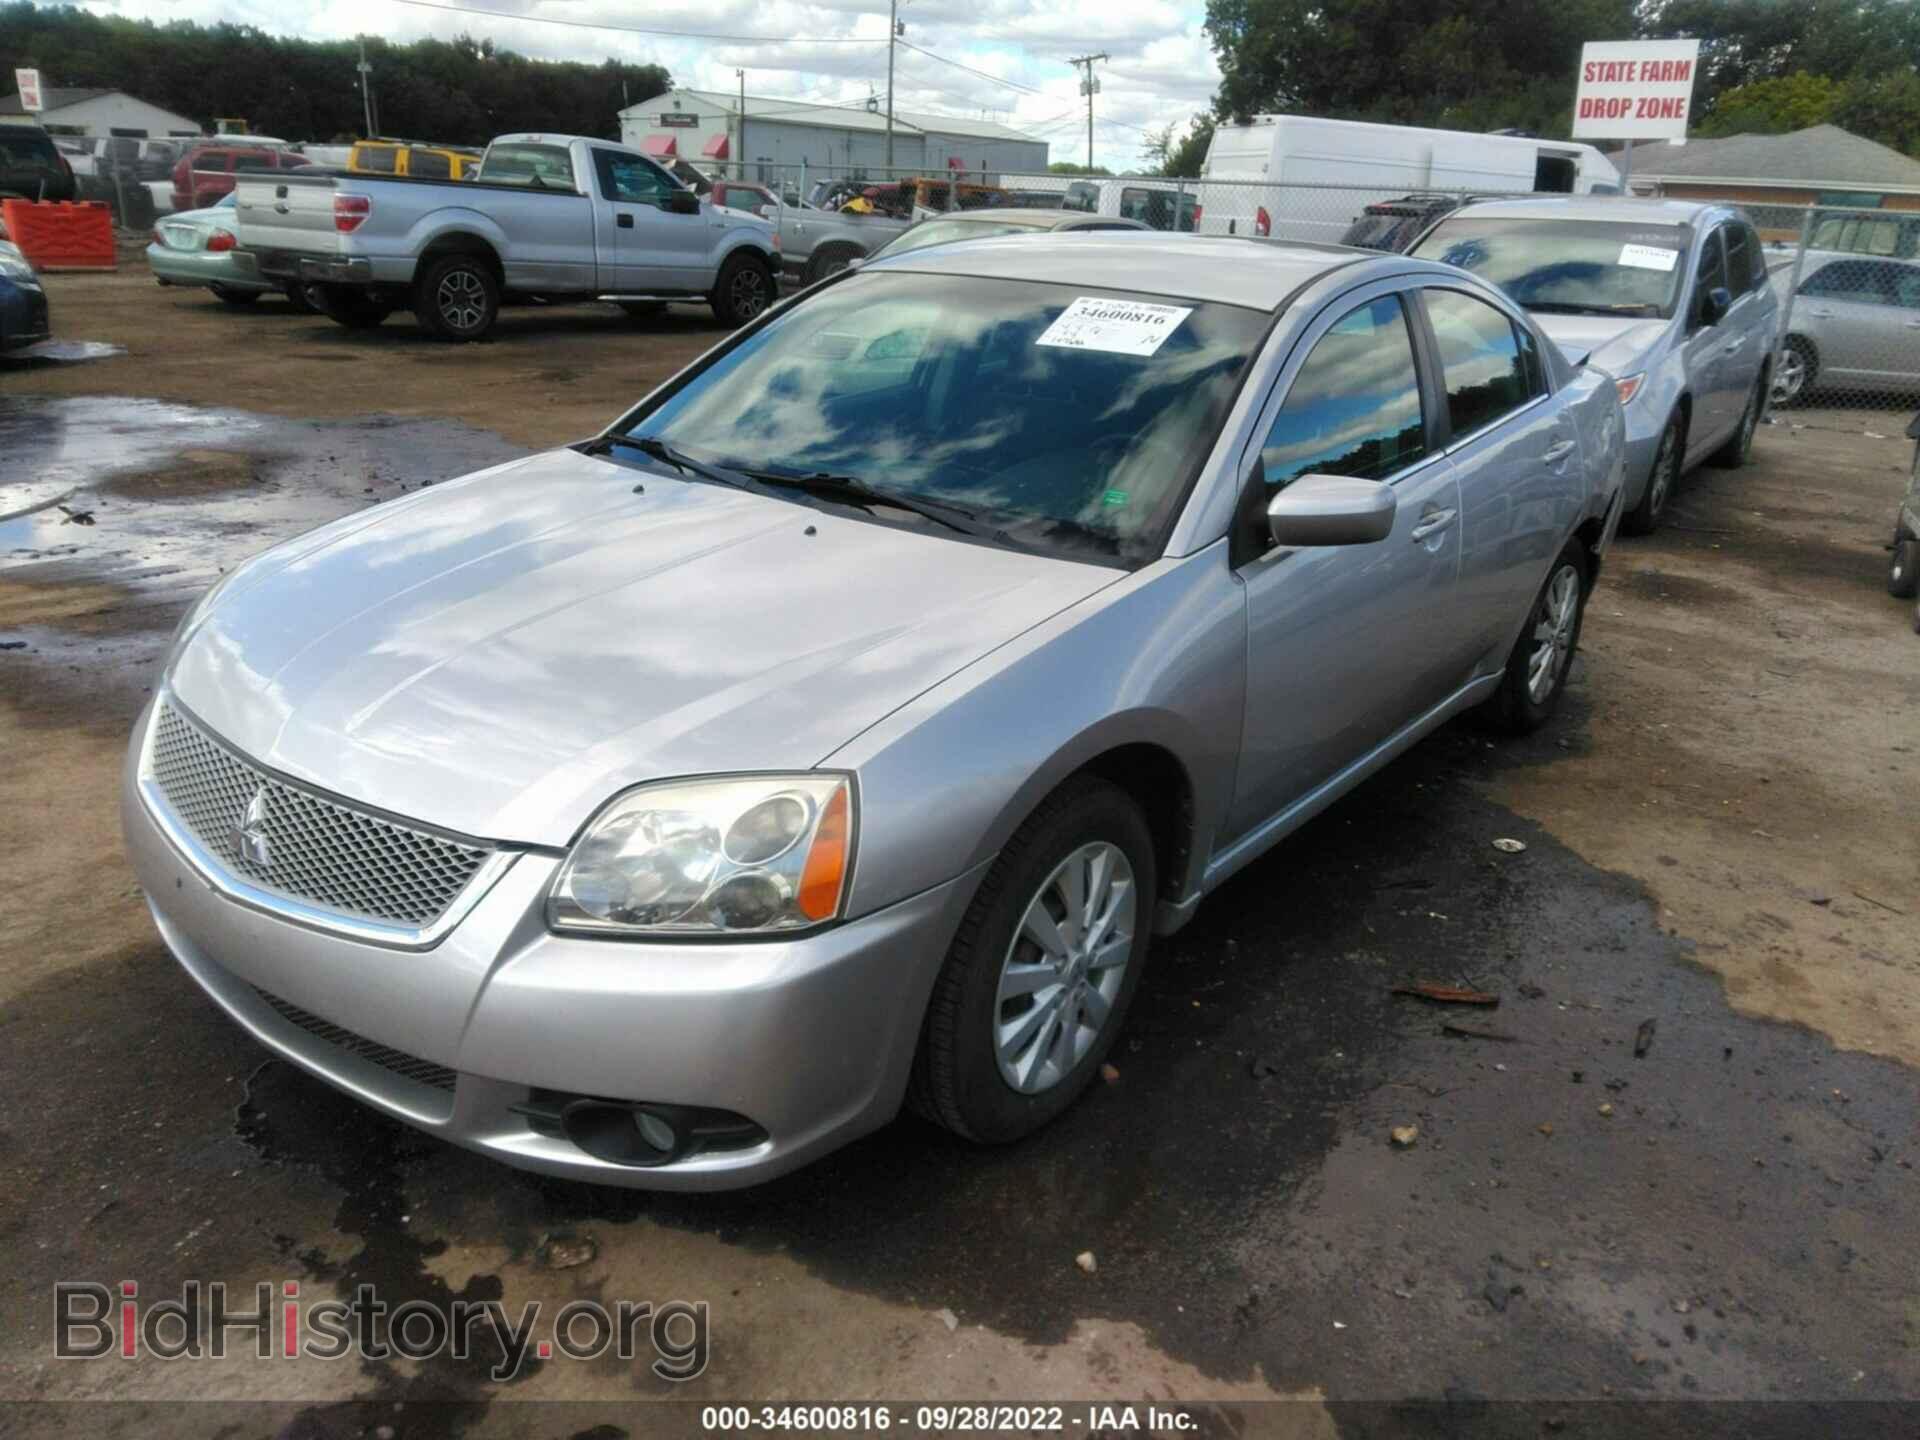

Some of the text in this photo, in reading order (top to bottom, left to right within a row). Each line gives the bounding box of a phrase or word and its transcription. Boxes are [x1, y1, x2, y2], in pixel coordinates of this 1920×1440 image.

[1584, 60, 1691, 82] STATE FARM
[1579, 97, 1685, 119] DROP ZONE
[1073, 306, 1166, 326] 34600816
